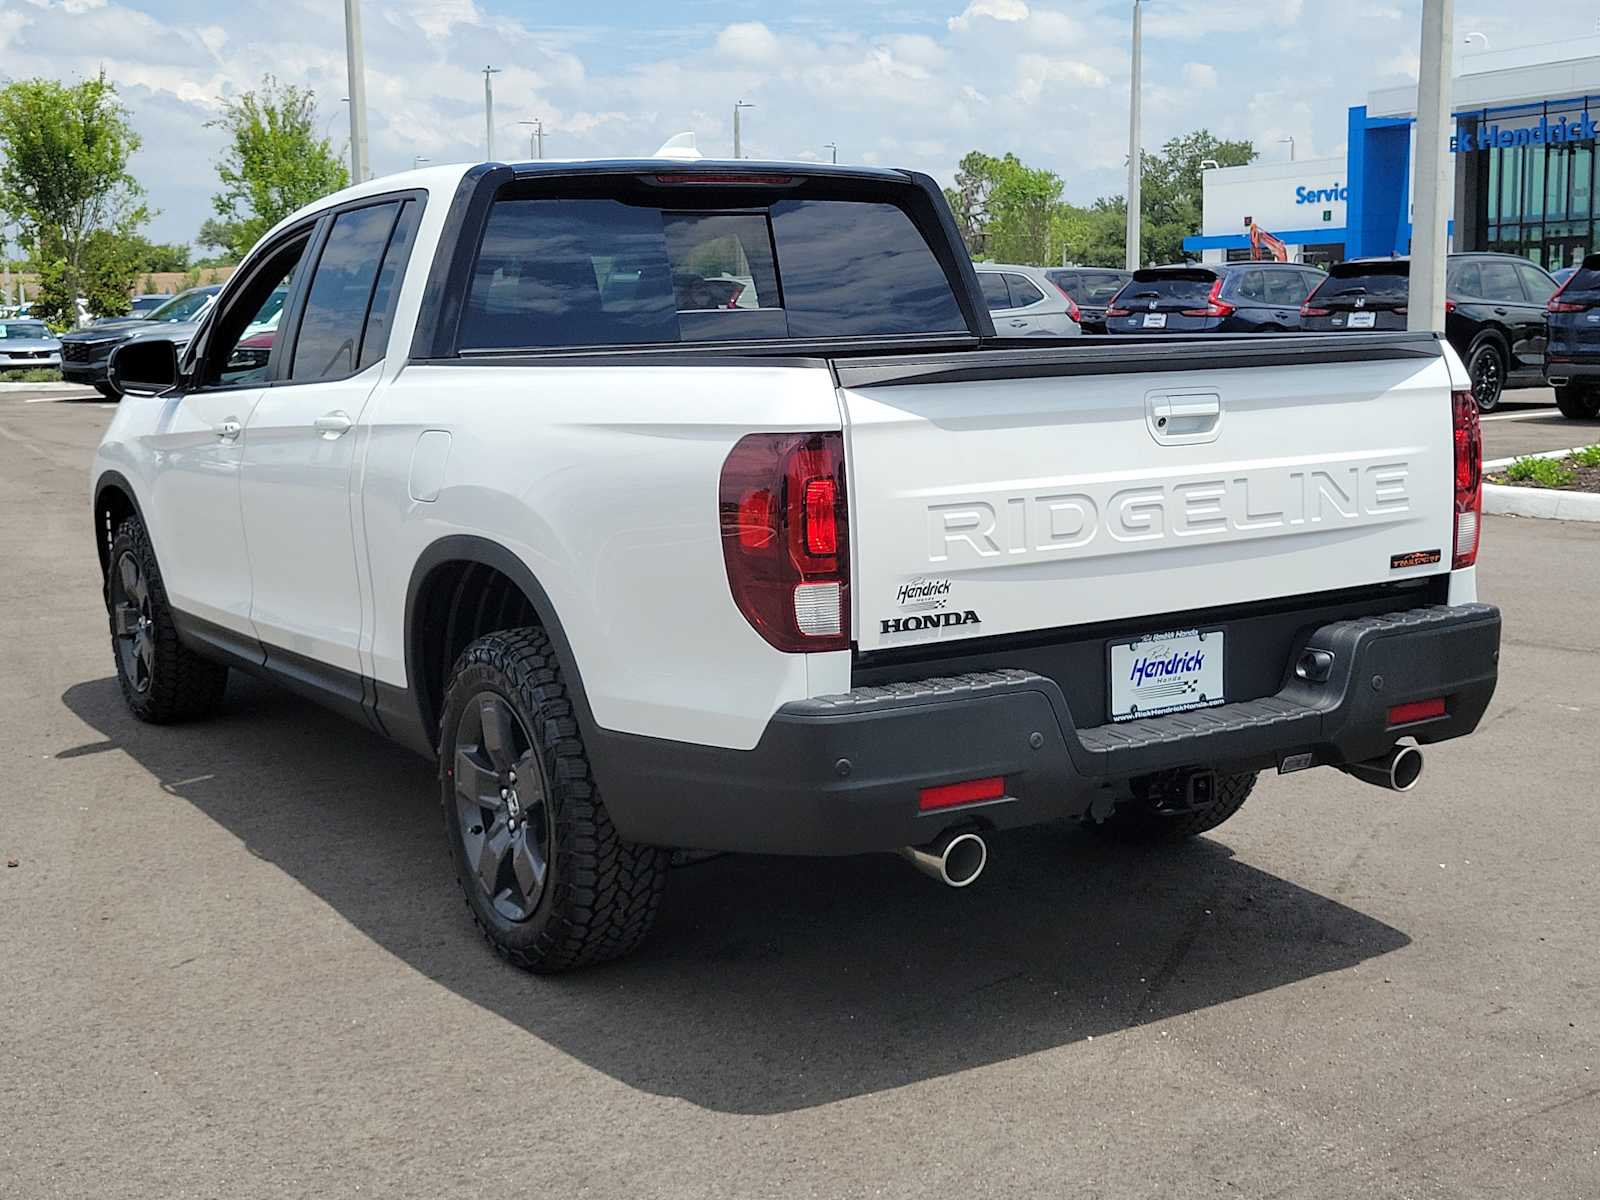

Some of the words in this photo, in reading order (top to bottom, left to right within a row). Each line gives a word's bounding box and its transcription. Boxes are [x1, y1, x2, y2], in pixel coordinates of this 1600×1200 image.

[1450, 126, 1472, 153] ck
[1478, 110, 1597, 150] Hendrick
[1296, 183, 1348, 205] Servic
[927, 462, 1410, 563] RIDGELINE
[897, 580, 952, 604] Hendrick
[880, 610, 982, 634] HONDA
[1130, 650, 1205, 687] Hendrick
